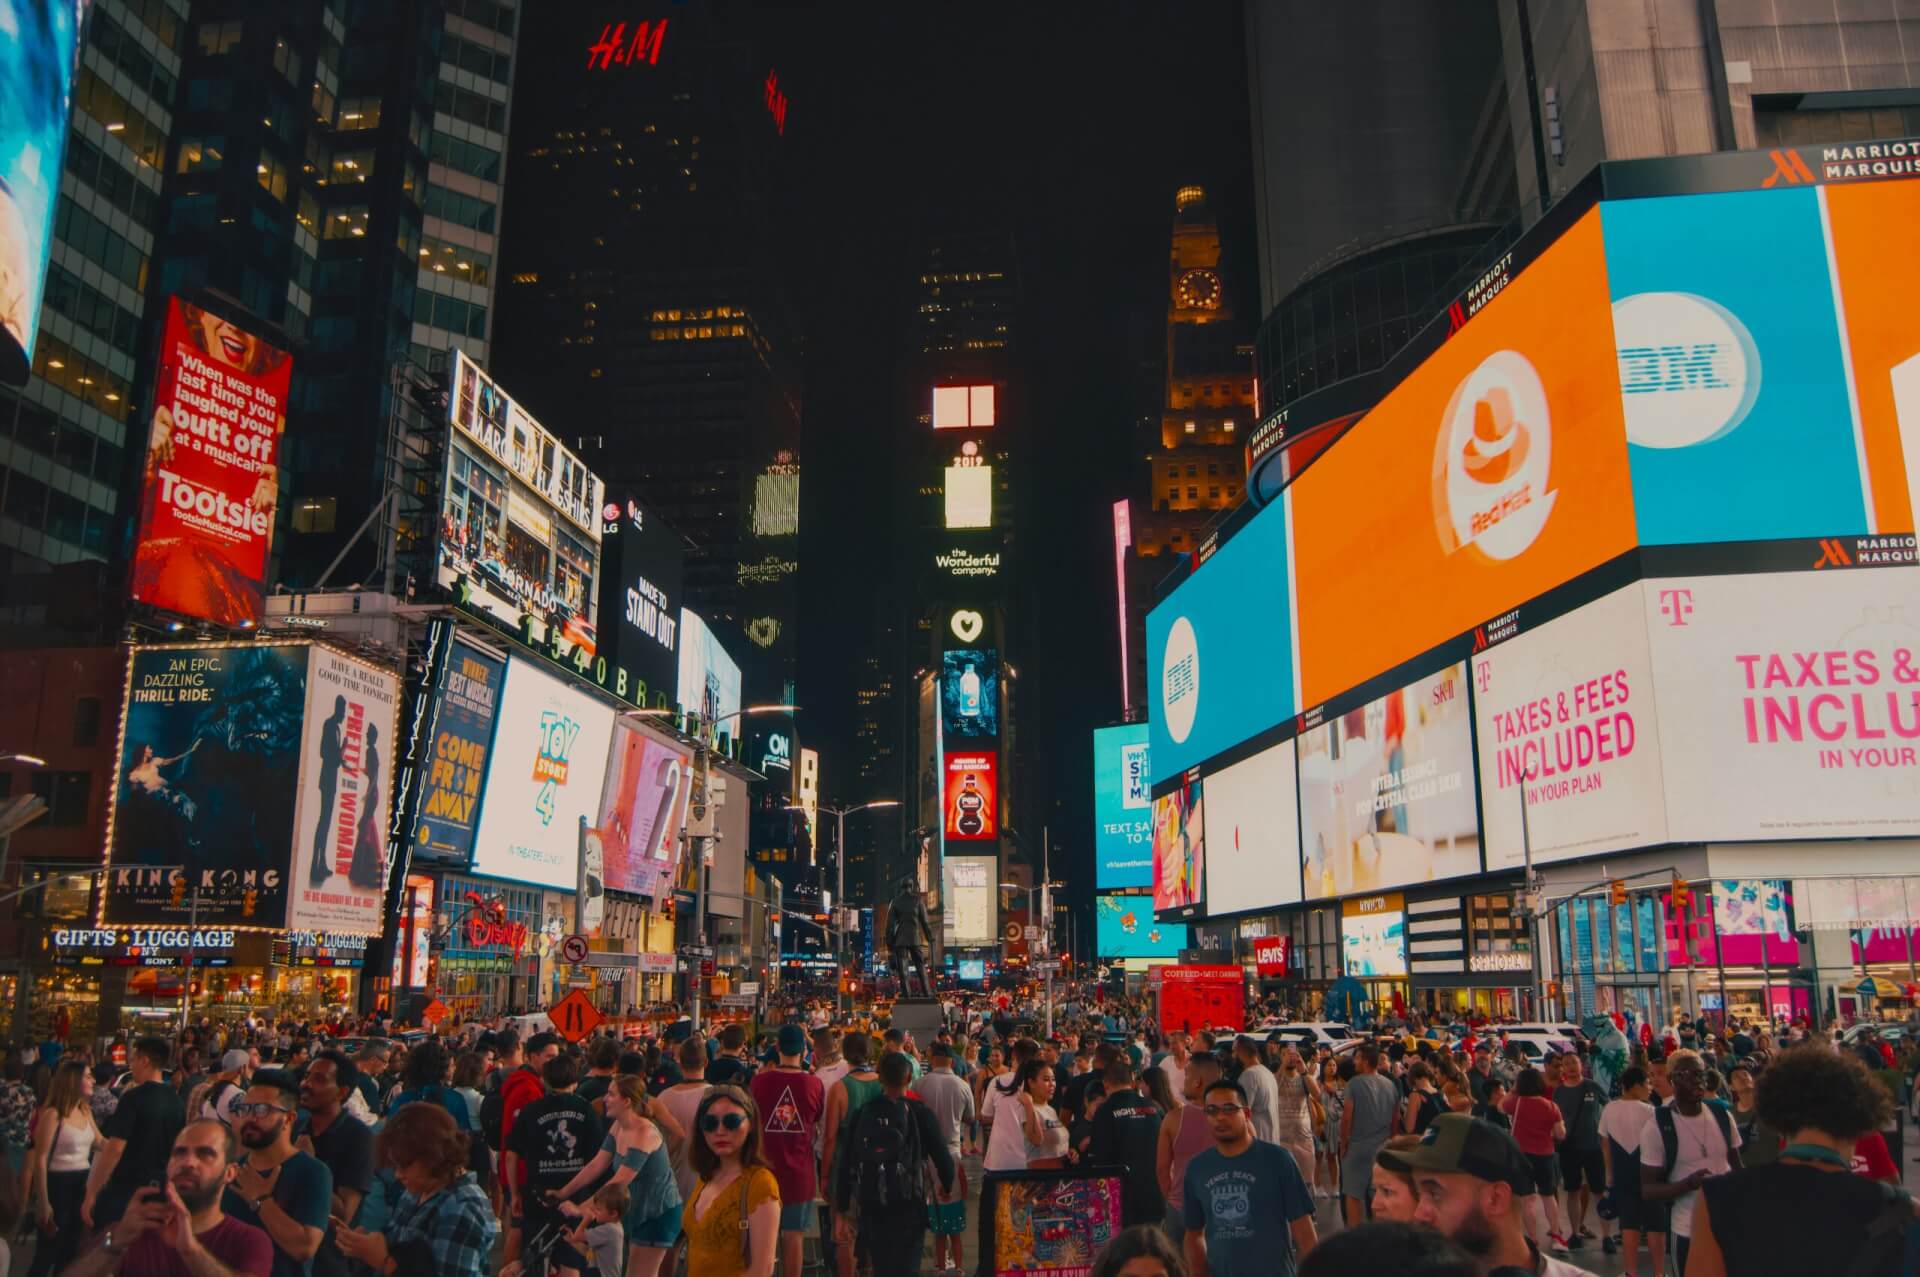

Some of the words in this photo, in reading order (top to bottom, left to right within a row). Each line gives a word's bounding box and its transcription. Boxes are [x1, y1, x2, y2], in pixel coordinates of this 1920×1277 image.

[587, 18, 668, 71] H&M
[1468, 252, 1512, 302] MARRIOTT
[1469, 273, 1508, 317] MARQUIS
[178, 366, 206, 392] last
[211, 381, 245, 408] time
[248, 401, 276, 423] you
[226, 375, 253, 396] was
[255, 387, 277, 407] the
[175, 384, 238, 423] laughed
[240, 415, 274, 437] your
[1252, 409, 1288, 446] MARRIOTT
[173, 400, 231, 447] butt
[234, 433, 272, 462] off
[174, 432, 190, 447] at
[192, 439, 201, 451] a
[1253, 428, 1284, 461] MARQUIS
[954, 457, 983, 467] 2019
[159, 469, 268, 535] Tootsie
[603, 523, 618, 533] LG
[936, 554, 999, 567] Wonderful
[952, 549, 966, 558] the
[639, 576, 658, 603] MADE
[658, 590, 667, 610] TO
[626, 587, 656, 638] STAND
[658, 611, 676, 651] OUT
[1488, 610, 1520, 632] MARRIOTT
[1488, 623, 1518, 643] MARQUIS
[526, 614, 607, 685] 1540
[144, 673, 205, 687] DAZZLING
[331, 659, 350, 675] HAVE
[353, 669, 357, 678] A
[360, 671, 384, 689] REALLY
[1736, 649, 1881, 689] TAXES
[1892, 647, 1920, 684] &
[135, 689, 175, 702] THRILL
[318, 668, 340, 684] GOOD
[343, 677, 360, 692] TIME
[363, 685, 393, 704] TONIGHT
[1493, 697, 1552, 744] TAXES
[1556, 691, 1570, 723] &
[1574, 669, 1630, 718] FEES
[342, 701, 364, 779] PRETTY
[437, 731, 485, 770] COME
[541, 711, 580, 764] TOY
[769, 733, 788, 757] ON
[1497, 711, 1635, 789] INCLUDED
[537, 758, 567, 780] STORY
[1819, 749, 1844, 769] IN
[1848, 747, 1917, 768] YOUR
[425, 788, 476, 823] AWAY
[536, 777, 557, 826] 4
[1528, 787, 1539, 806] IN
[1540, 779, 1569, 802] YOUR
[1572, 771, 1602, 794] PLAN
[336, 792, 358, 876] WOMAN
[1104, 823, 1132, 835] TEXT
[1127, 833, 1142, 843] TO
[55, 930, 117, 946] GIFTS
[132, 931, 235, 947] LUGGAGE
[324, 932, 368, 949] LUGGAGE
